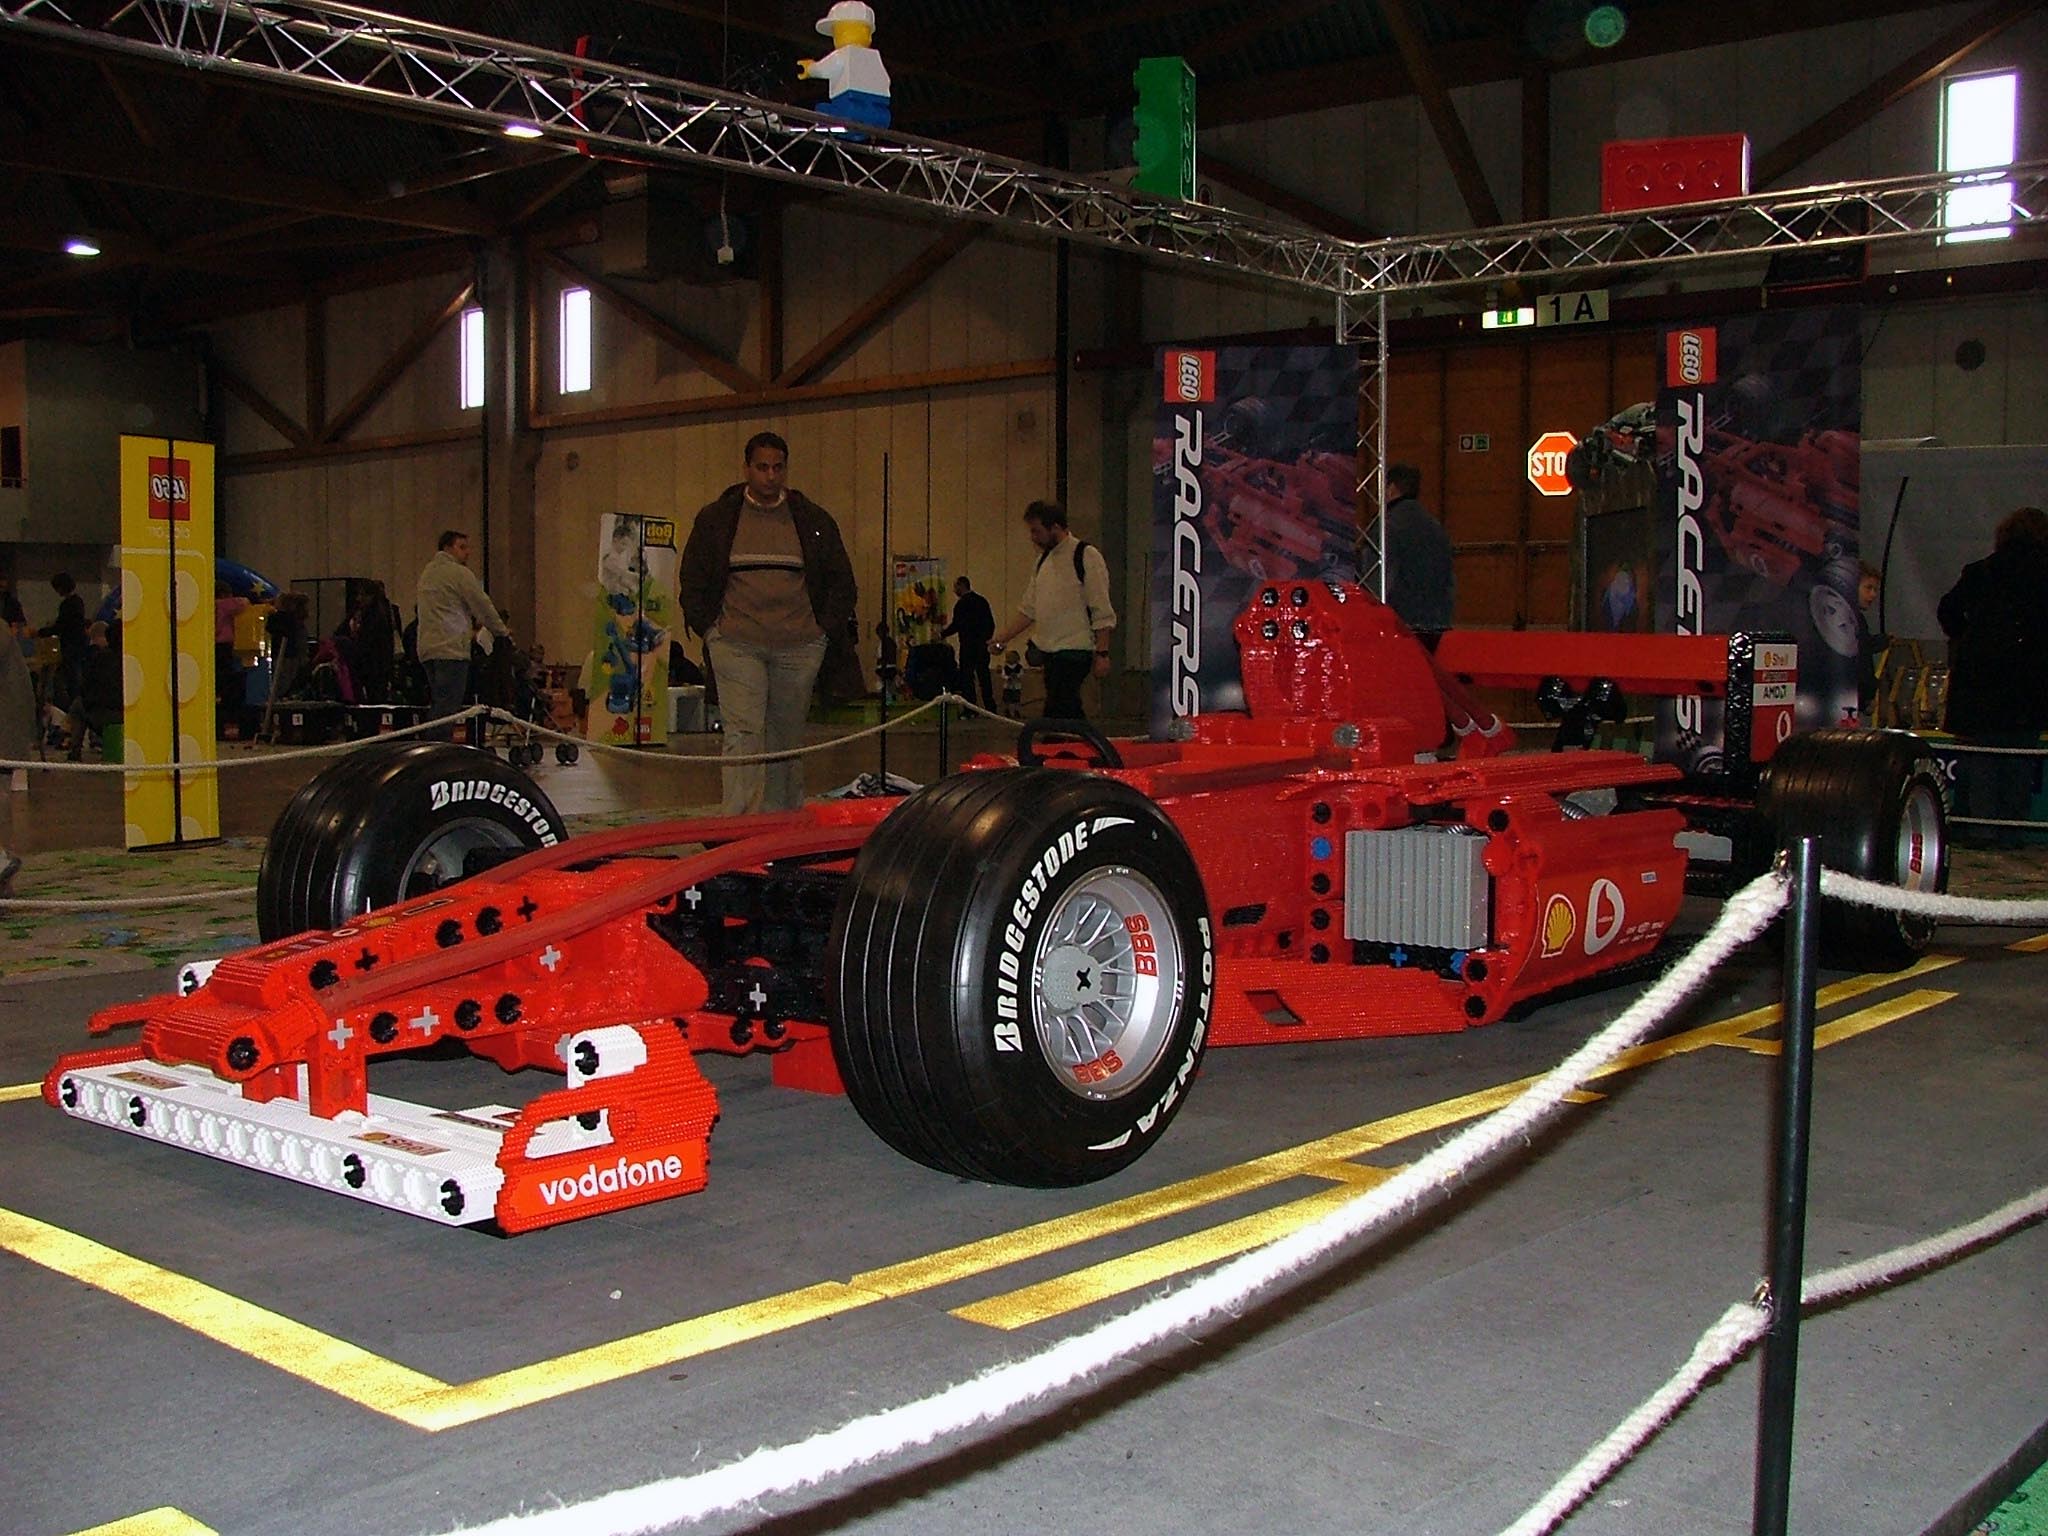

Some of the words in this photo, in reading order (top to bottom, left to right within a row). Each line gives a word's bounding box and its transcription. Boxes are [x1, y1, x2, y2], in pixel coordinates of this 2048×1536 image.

[1550, 296, 1561, 323] 1
[1573, 293, 1595, 321] A
[1179, 353, 1201, 401] LEGO
[1680, 333, 1701, 384] LEGO
[1532, 451, 1567, 477] STO
[1172, 410, 1202, 717] RACERS
[1676, 392, 1704, 735] RACES
[430, 780, 559, 848] BRIDGESTON
[993, 821, 1090, 1052] BRIDGESTONE
[1124, 912, 1159, 977] BBS
[1136, 917, 1213, 1133] POTENZA
[1072, 1049, 1124, 1085] BBS
[538, 1155, 683, 1206] vodafone
